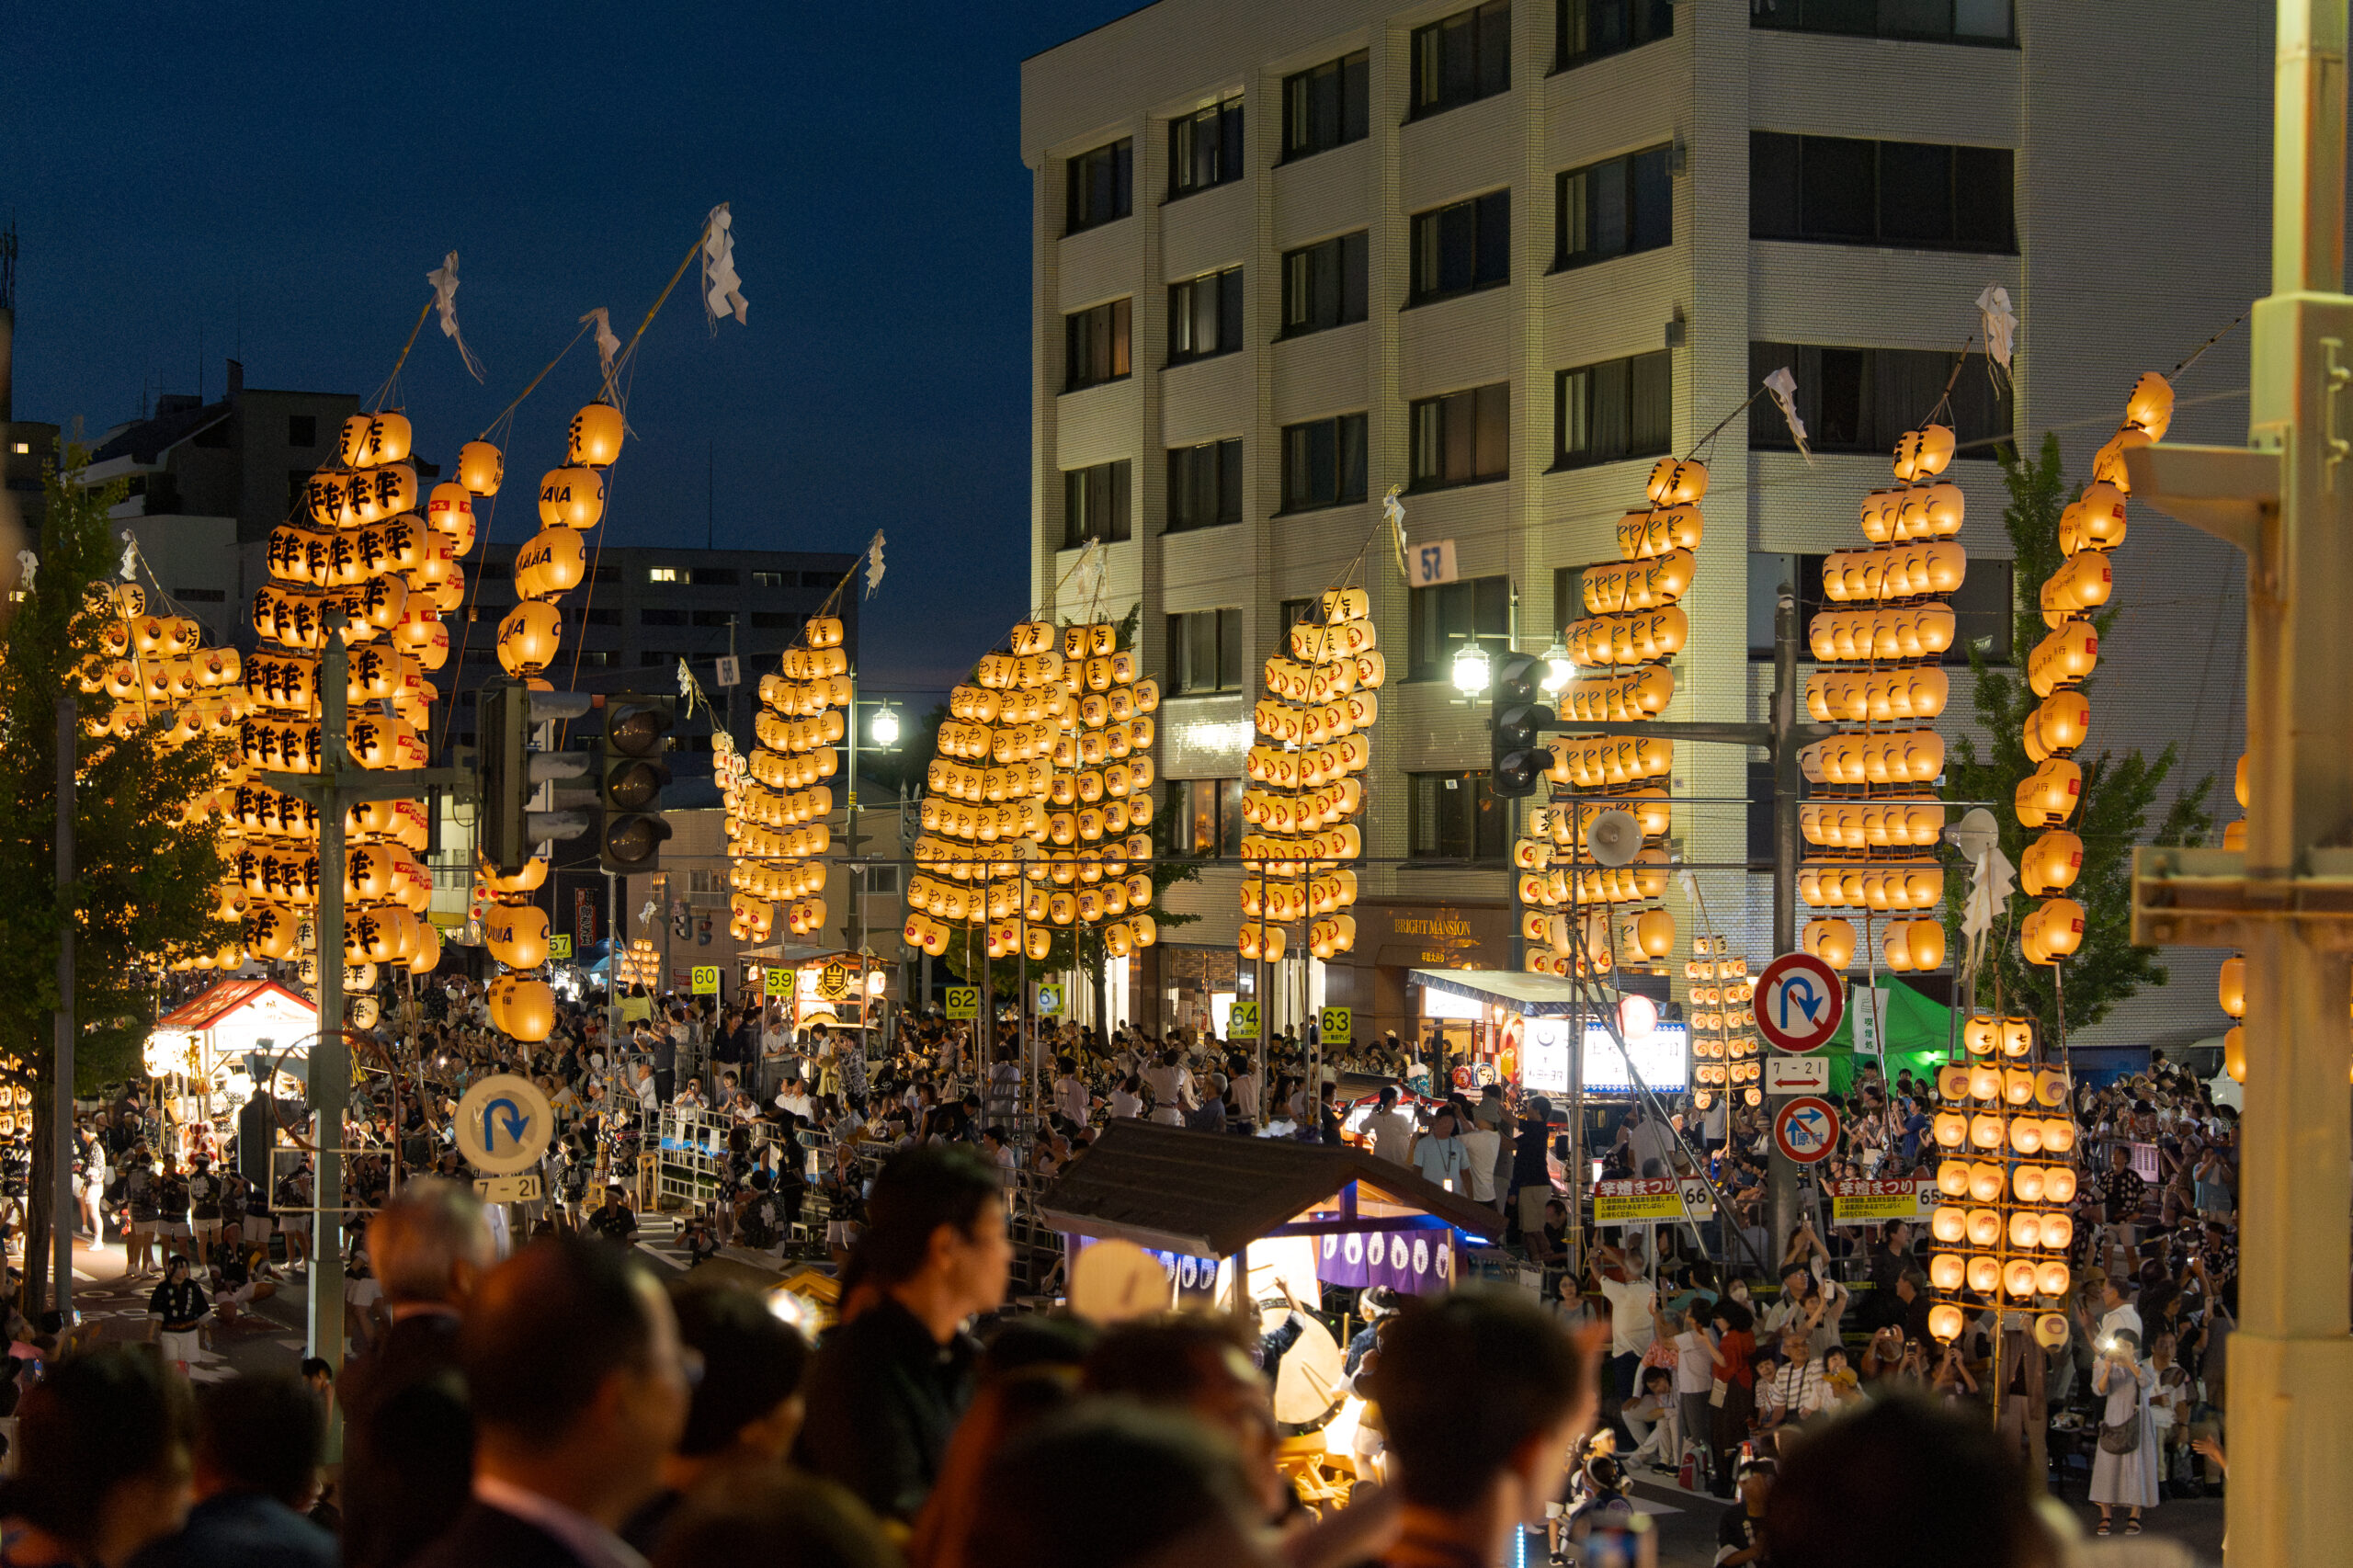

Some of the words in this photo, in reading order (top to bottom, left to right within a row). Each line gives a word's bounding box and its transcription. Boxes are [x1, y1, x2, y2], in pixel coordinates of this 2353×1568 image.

[131, 590, 143, 615] 七夕
[1067, 631, 1079, 653] 七夕
[1094, 629, 1107, 649] 七夕
[1394, 919, 1428, 935] BRIGHT
[1429, 920, 1471, 936] MANSION
[549, 937, 568, 951] 57
[694, 969, 715, 984] 60
[768, 971, 792, 988] 59
[949, 990, 976, 1008] 62
[1040, 987, 1061, 1006] 61
[1232, 1006, 1258, 1027] 64
[1322, 1011, 1349, 1031] 63
[1773, 1062, 1780, 1074] 7
[1805, 1061, 1822, 1074] 21
[1798, 1131, 1824, 1147] 原付
[480, 1182, 489, 1196] 7
[518, 1179, 536, 1197] 21
[1686, 1187, 1707, 1205] 66
[1838, 1179, 1913, 1197] 竿燈まつり
[1920, 1188, 1940, 1206] 65
